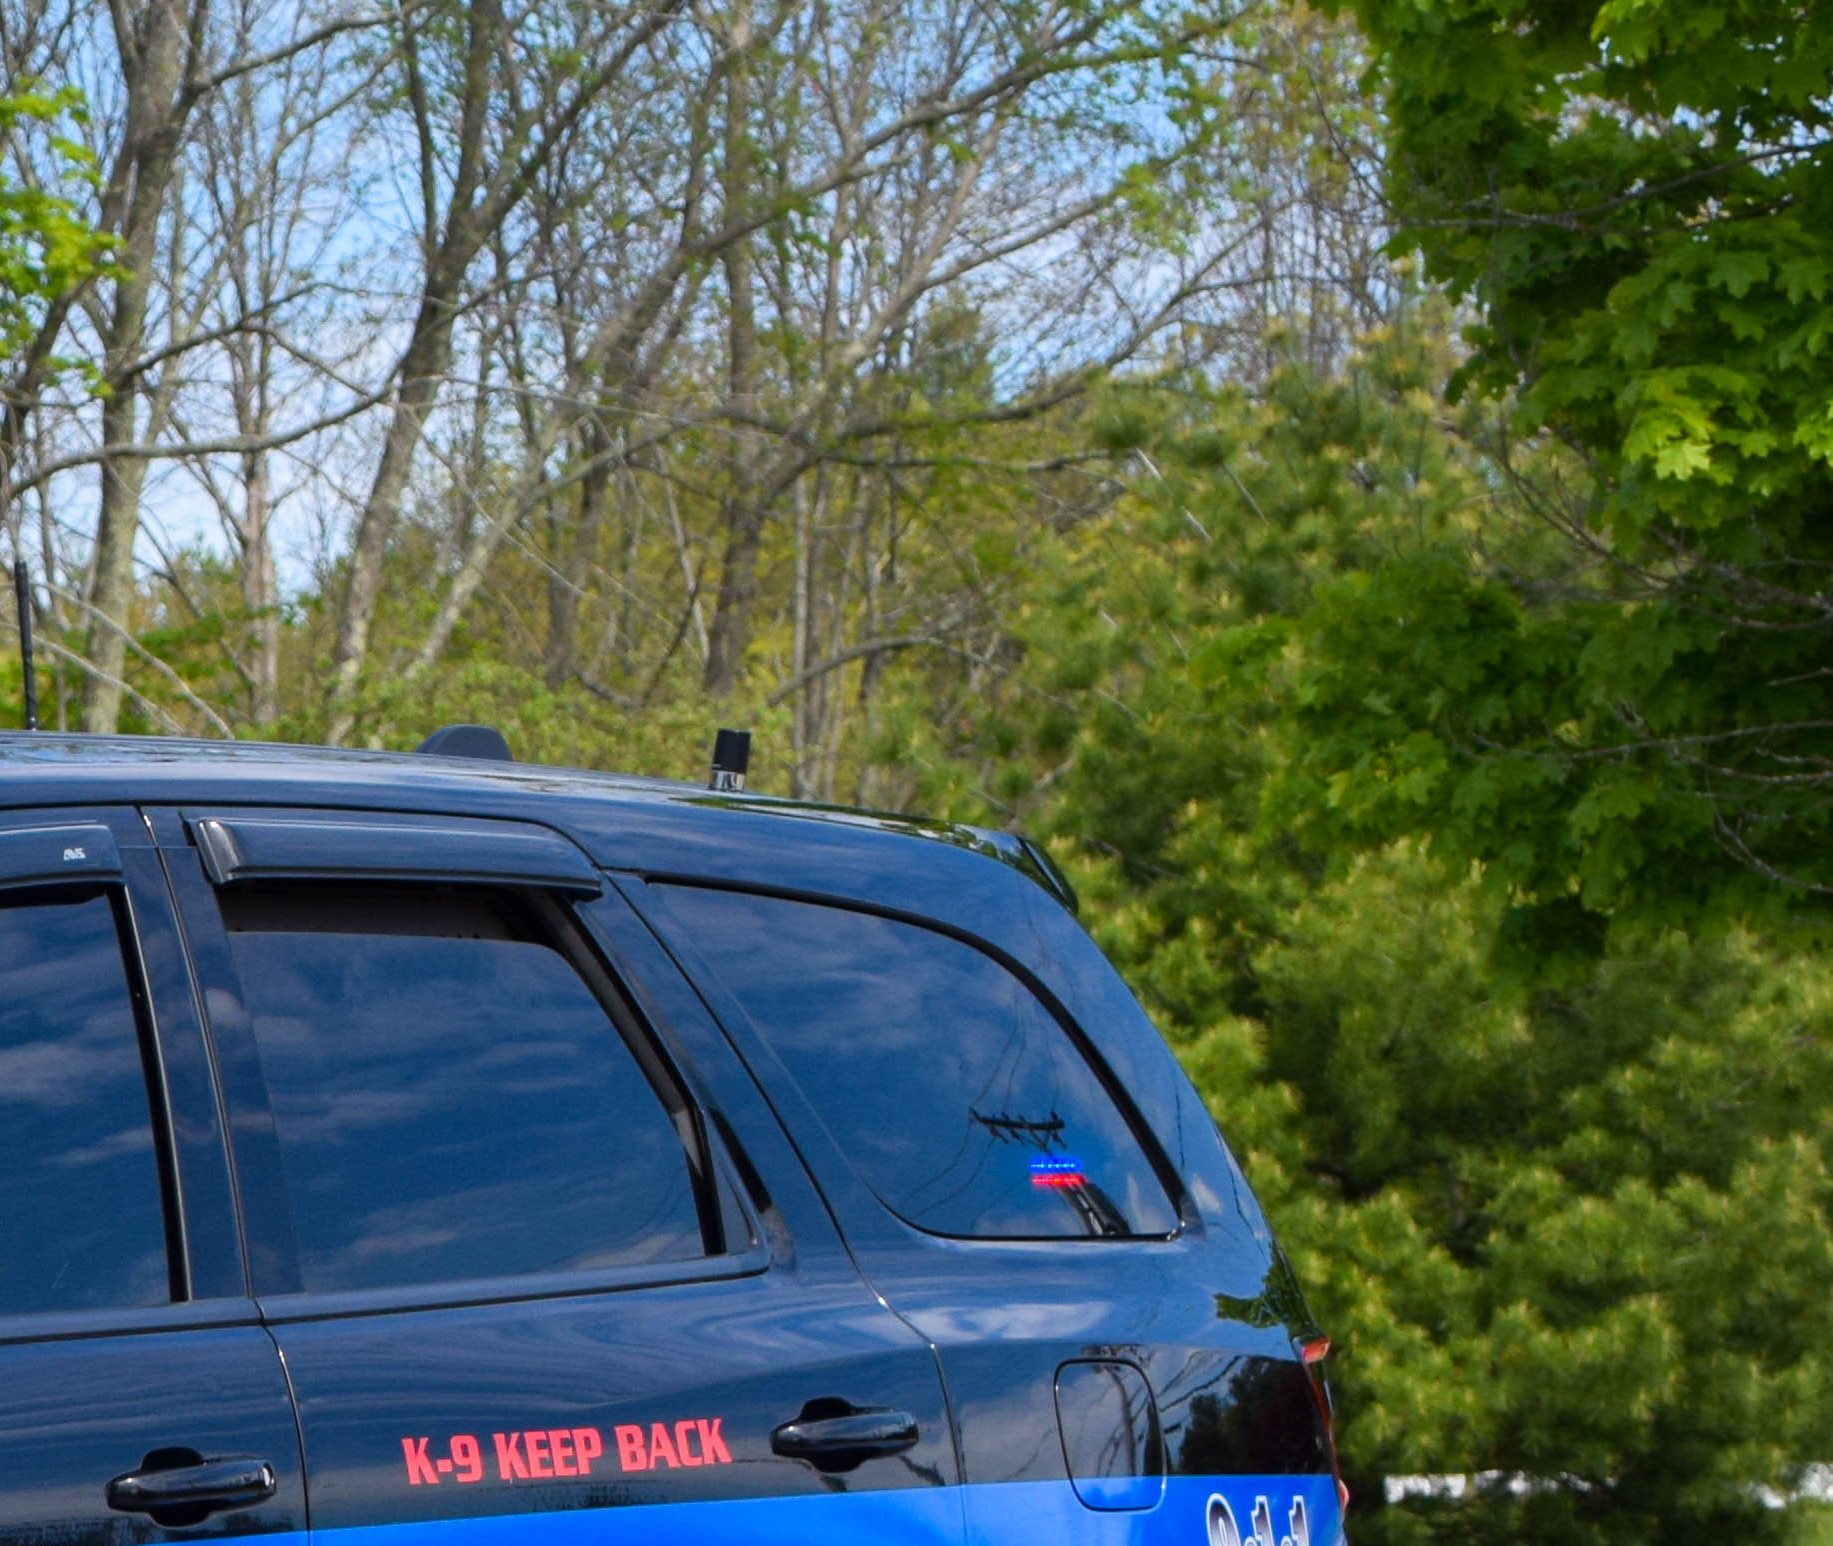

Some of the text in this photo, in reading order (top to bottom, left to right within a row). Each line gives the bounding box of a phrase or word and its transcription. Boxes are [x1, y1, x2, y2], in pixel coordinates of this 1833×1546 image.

[401, 1417, 732, 1485] K-9 KEEP BACK
